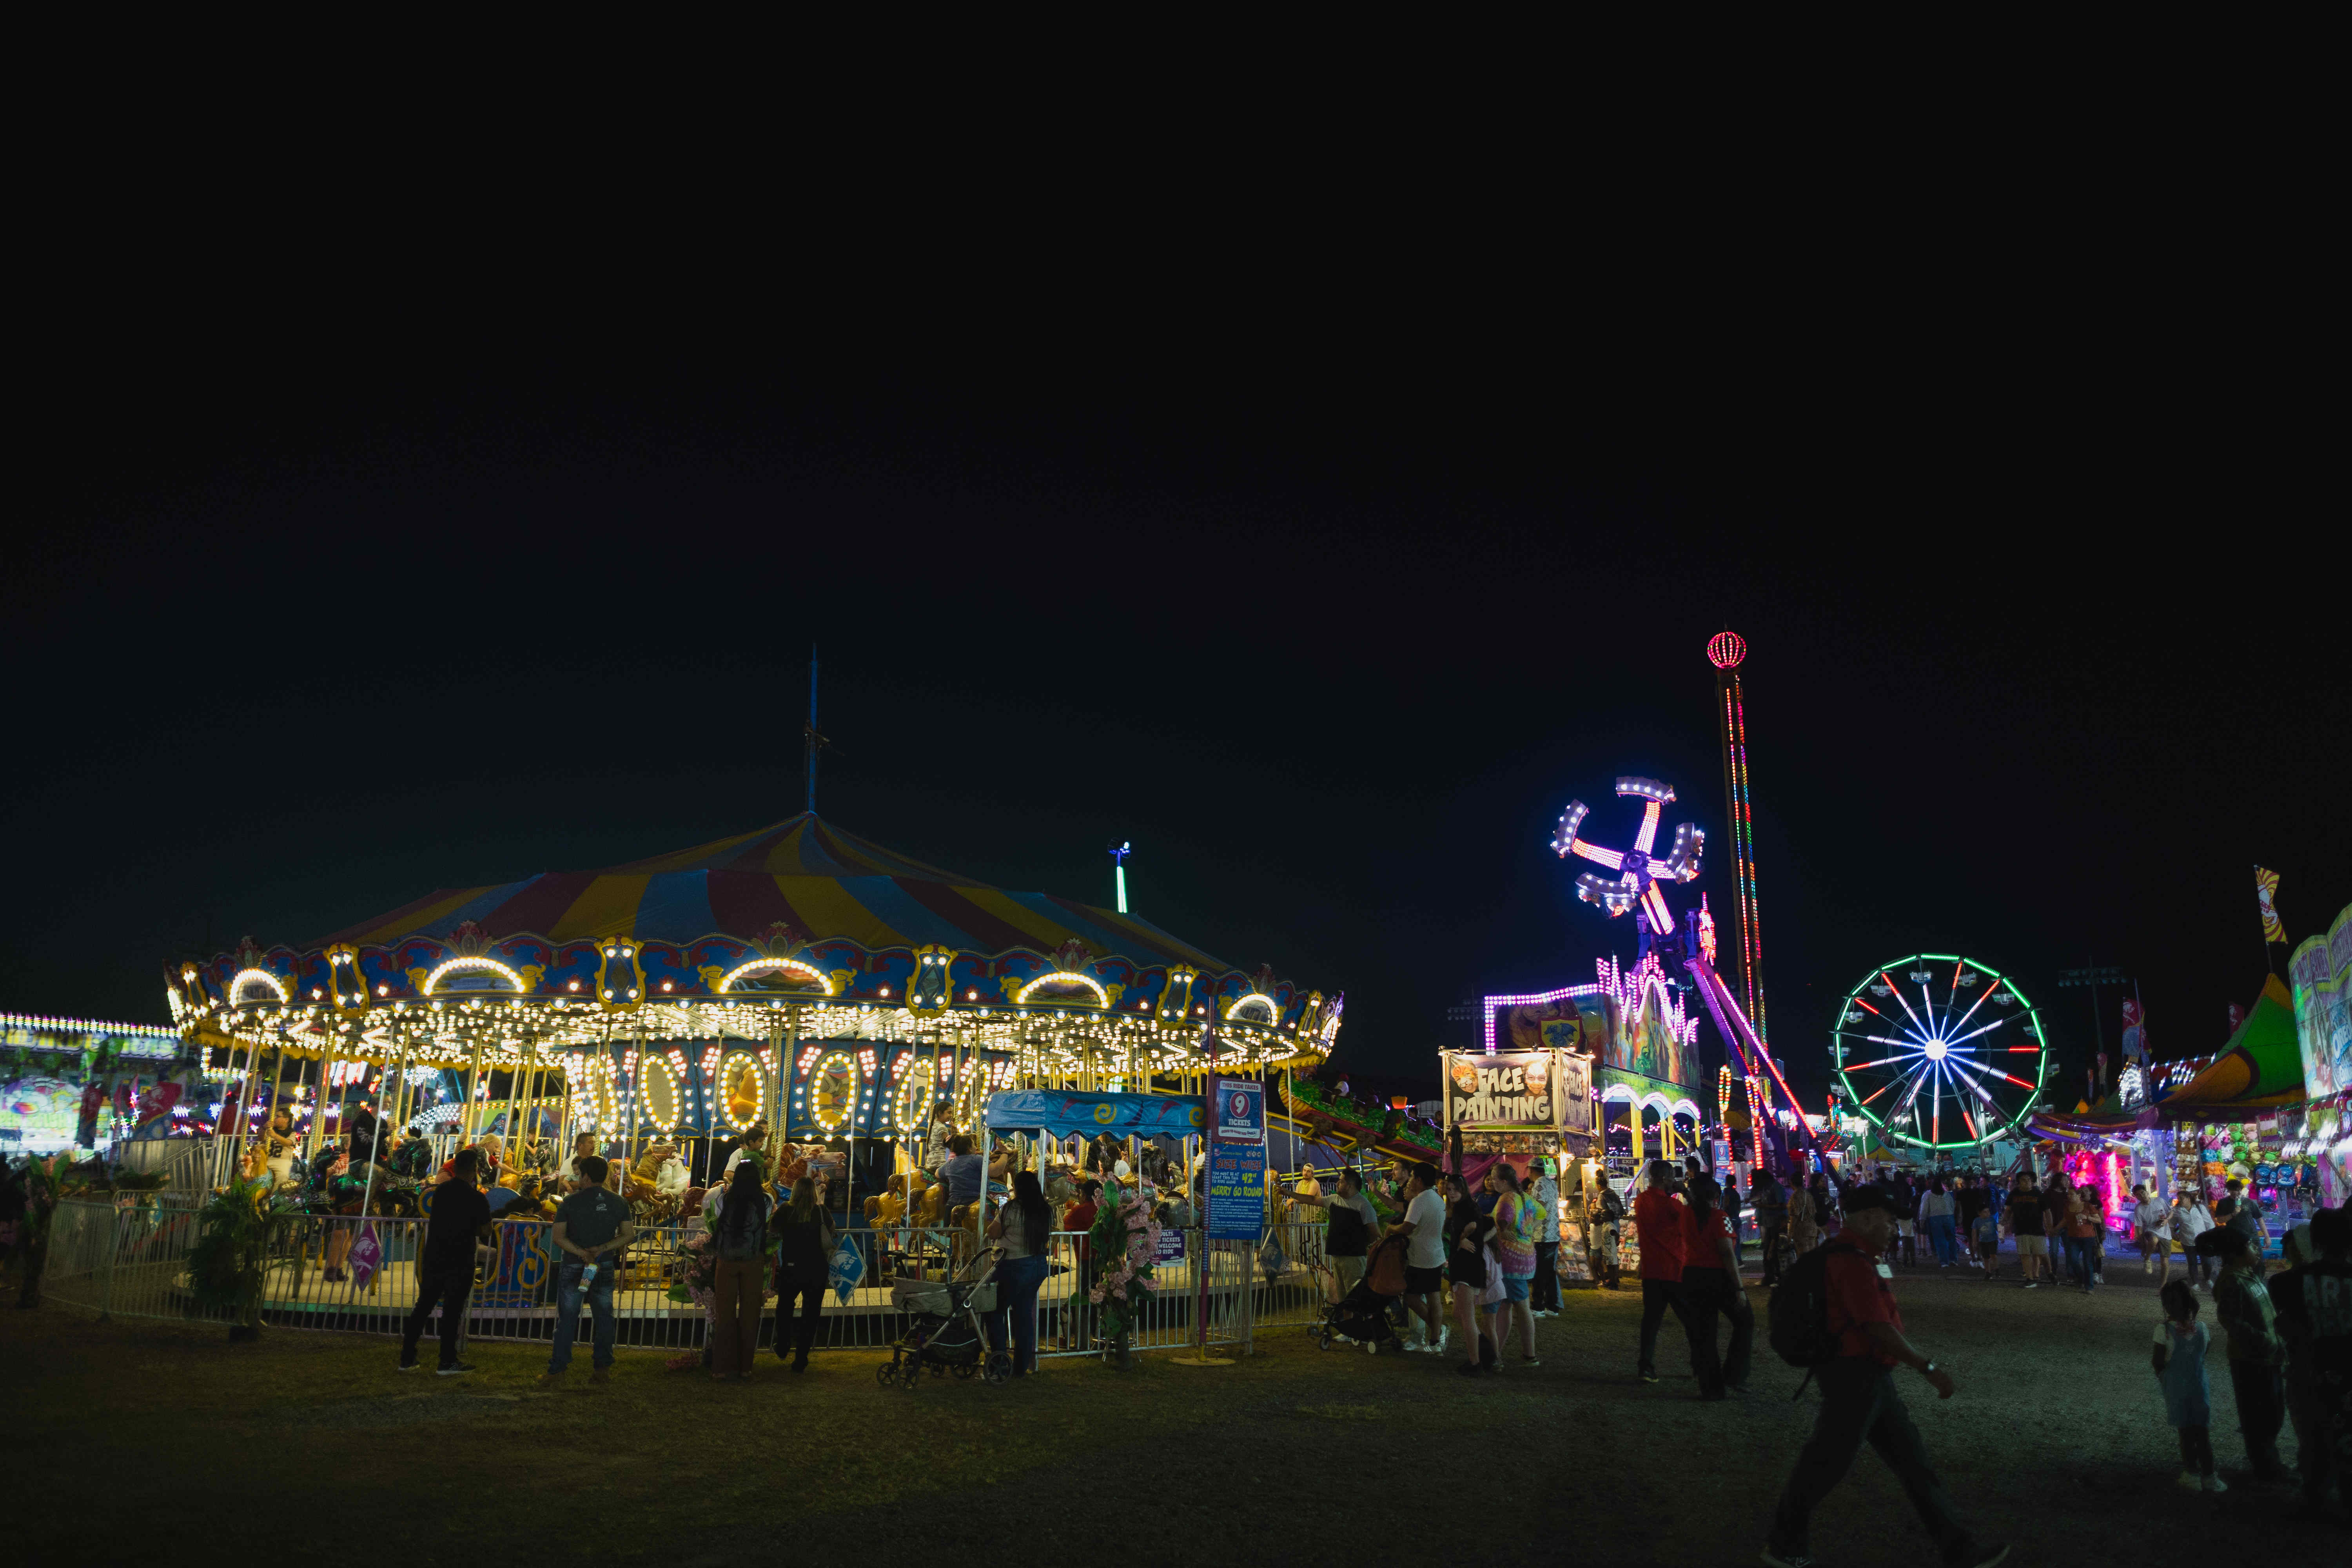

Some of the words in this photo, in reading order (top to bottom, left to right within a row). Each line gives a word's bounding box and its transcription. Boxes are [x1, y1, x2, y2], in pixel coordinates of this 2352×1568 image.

[2333, 1024, 2352, 1059] OREO
[1477, 1067, 1524, 1092] FACE
[1569, 1070, 1583, 1096] FACE
[1235, 1096, 1245, 1114] 9
[1453, 1096, 1550, 1122] PAINTING
[1216, 1158, 1237, 1170] SIZE
[1240, 1160, 1262, 1171] WIZE
[1210, 1185, 1232, 1196] MERRY
[1233, 1186, 1242, 1197] GO
[1243, 1186, 1262, 1197] ROUND
